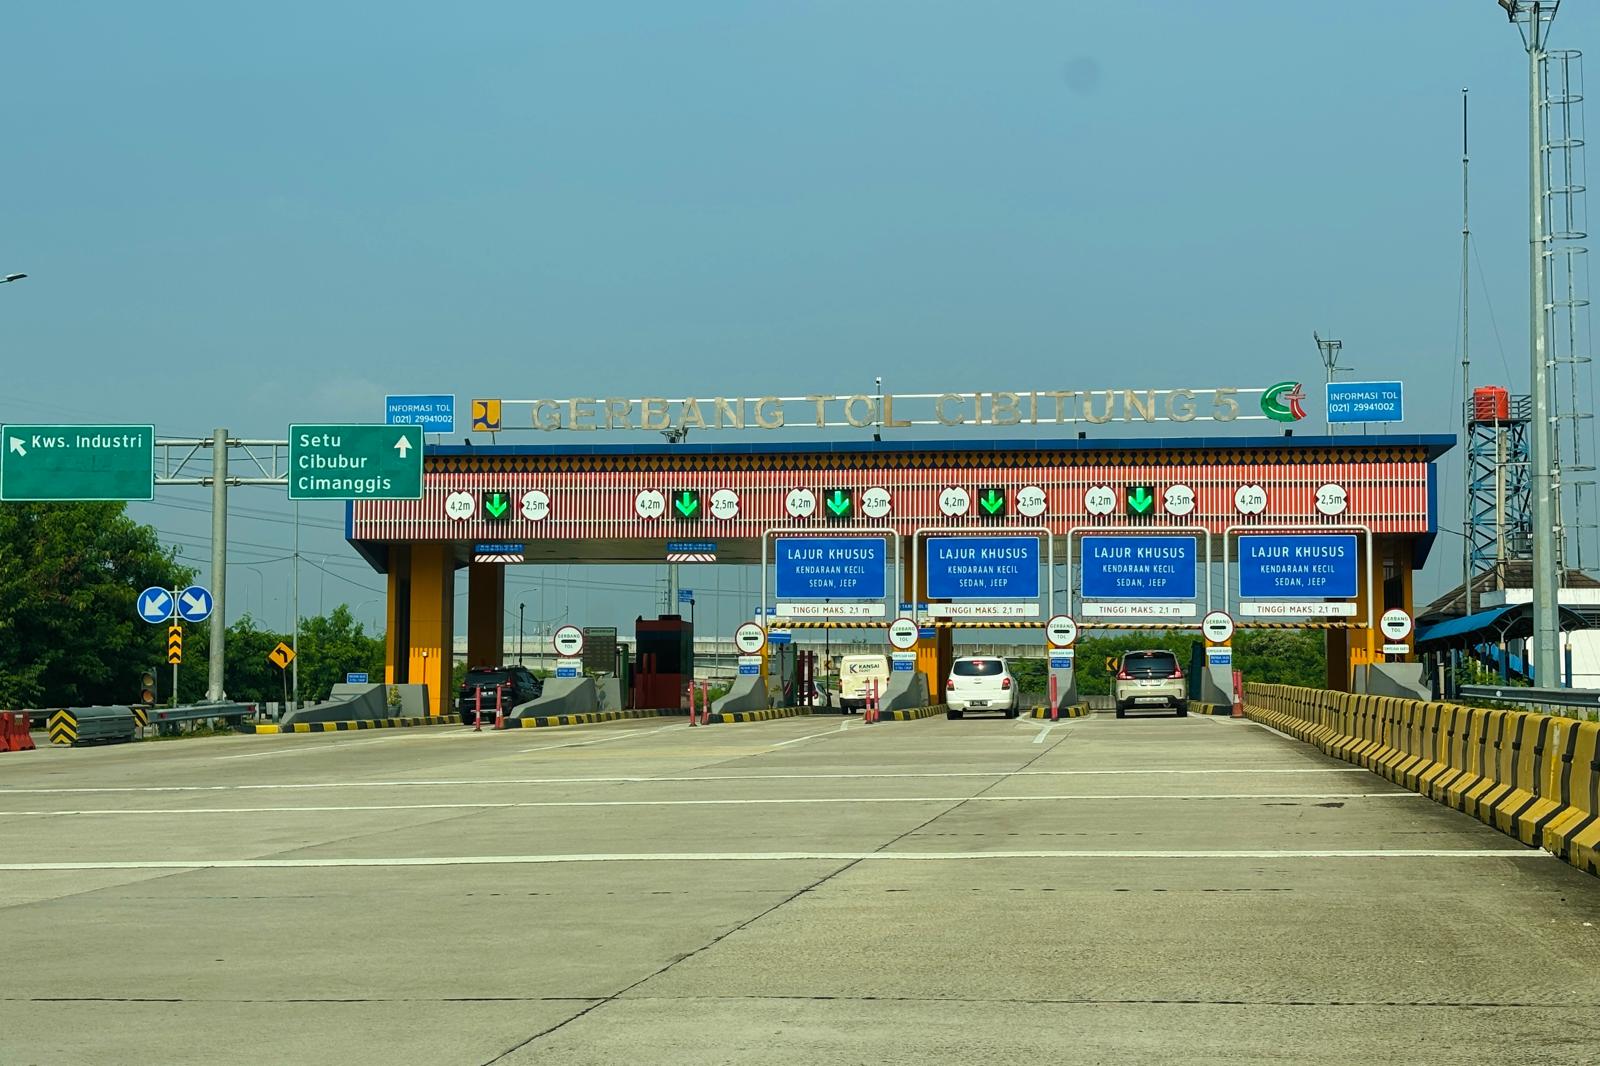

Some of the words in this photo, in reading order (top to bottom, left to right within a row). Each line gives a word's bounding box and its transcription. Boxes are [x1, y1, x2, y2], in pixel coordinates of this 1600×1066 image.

[1330, 391, 1378, 401] INFORMASI
[1381, 391, 1399, 400] TOL
[389, 404, 433, 412] INFORMASI
[436, 404, 451, 412] TOL
[532, 396, 785, 431] GERBANG
[806, 394, 912, 428] TOL
[935, 388, 1197, 426] CIBITUNG
[1212, 387, 1240, 423] 5
[1329, 402, 1350, 414] (021)
[1353, 402, 1395, 412] 29941002
[392, 414, 412, 425] (021)
[414, 414, 453, 423] 29941002
[31, 435, 70, 448] Kws.
[76, 433, 142, 448] Industri
[300, 433, 341, 448] Setu
[299, 454, 368, 469] Cibubur
[298, 475, 391, 494] Cimanggis
[640, 499, 661, 510] 4,2m
[714, 499, 735, 510] 2,5m
[790, 498, 811, 509] 4,2m
[866, 497, 887, 509] 2,5m
[944, 496, 965, 508] 4,2m
[1021, 496, 1042, 508] 2,5m
[1090, 495, 1112, 507] 4,2m
[1169, 495, 1190, 507] 2,5m
[1240, 494, 1262, 506] 4,2m
[1321, 493, 1342, 506] 2,5m
[450, 500, 471, 511] 4,2m
[525, 500, 545, 511] 2,5m
[788, 548, 823, 560] LAJUR
[828, 548, 875, 560] KHUSUS
[939, 548, 975, 559] LAJUR
[981, 547, 1028, 559] KHUSUS
[1094, 547, 1131, 559] LAJUR
[1137, 547, 1185, 559] KHUSUS
[1251, 546, 1289, 558] LAJUR
[1295, 546, 1345, 558] KHUSUS
[795, 565, 840, 574] KENDARAAN
[844, 565, 865, 574] KECIL
[947, 565, 993, 574] KENDARAAN
[997, 565, 1018, 574] KECIL
[1102, 564, 1149, 573] KENDARAAN
[1153, 564, 1175, 573] KECIL
[1260, 564, 1309, 573] KENDARAAN
[1312, 564, 1335, 573] KECIL
[809, 578, 836, 588] SEDAN,
[839, 578, 857, 588] JEEP
[959, 578, 987, 589] SEDAN,
[990, 578, 1008, 587] JEEP
[1116, 578, 1145, 588] SEDAN,
[1149, 578, 1167, 587] JEEP
[1274, 577, 1304, 588] SEDAN,
[1307, 577, 1326, 586] JEEP
[792, 606, 819, 614] TINGGI
[822, 606, 846, 614] MAKS.
[849, 606, 859, 615] 2,1
[944, 606, 972, 614] TINGGI
[975, 606, 999, 614] MAKS.
[1002, 606, 1012, 615] 2,1
[1099, 606, 1127, 614] TINGGI
[1130, 606, 1156, 614] MAKS.
[1158, 606, 1169, 614] 2,1
[1257, 606, 1286, 614] TINGGI
[1289, 606, 1315, 614] MAKS.
[1318, 606, 1328, 614] 2,1
